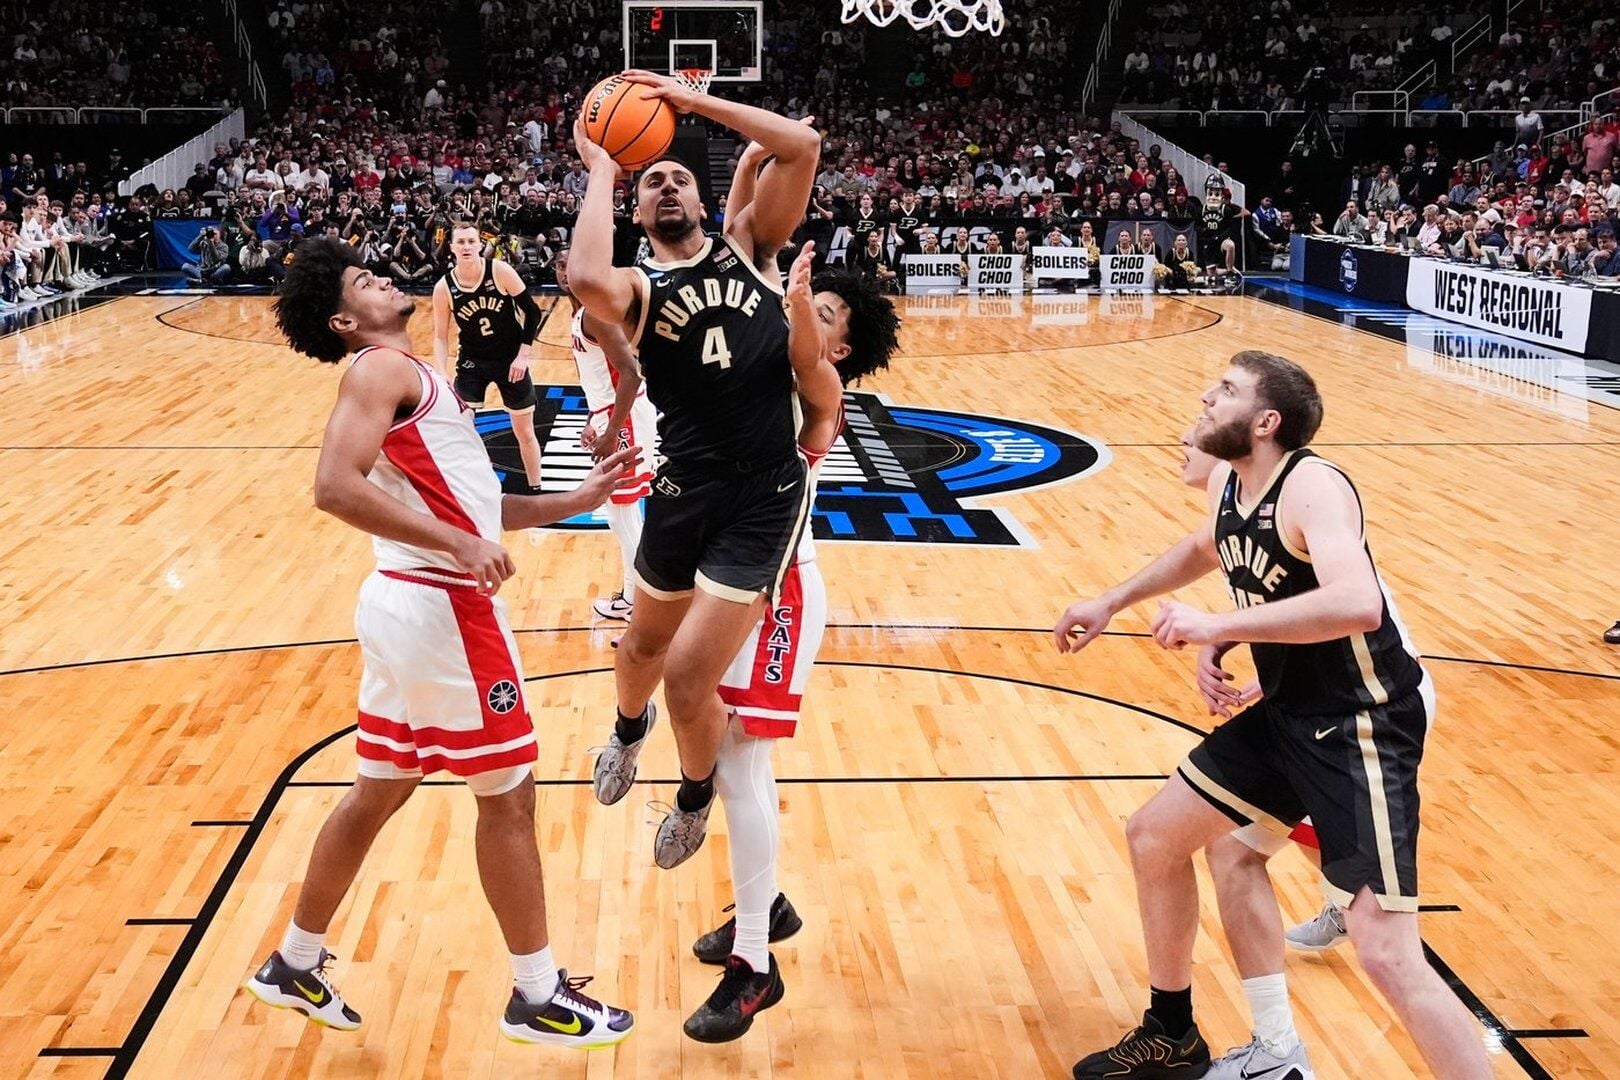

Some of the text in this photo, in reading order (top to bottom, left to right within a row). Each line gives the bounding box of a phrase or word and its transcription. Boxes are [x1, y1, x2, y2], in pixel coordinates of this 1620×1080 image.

[907, 262, 960, 278] BOILERS
[978, 255, 1012, 269] CHOO
[1034, 254, 1087, 270] BOILERS
[1110, 255, 1144, 270] CHOO
[978, 271, 1012, 285] CHOO
[1110, 271, 1144, 285] CHOO
[654, 277, 762, 342] PURDUE
[1434, 268, 1564, 340] WEST REGIONAL
[479, 317, 494, 337] 2
[701, 325, 732, 370] 4
[764, 606, 793, 684] CATS
